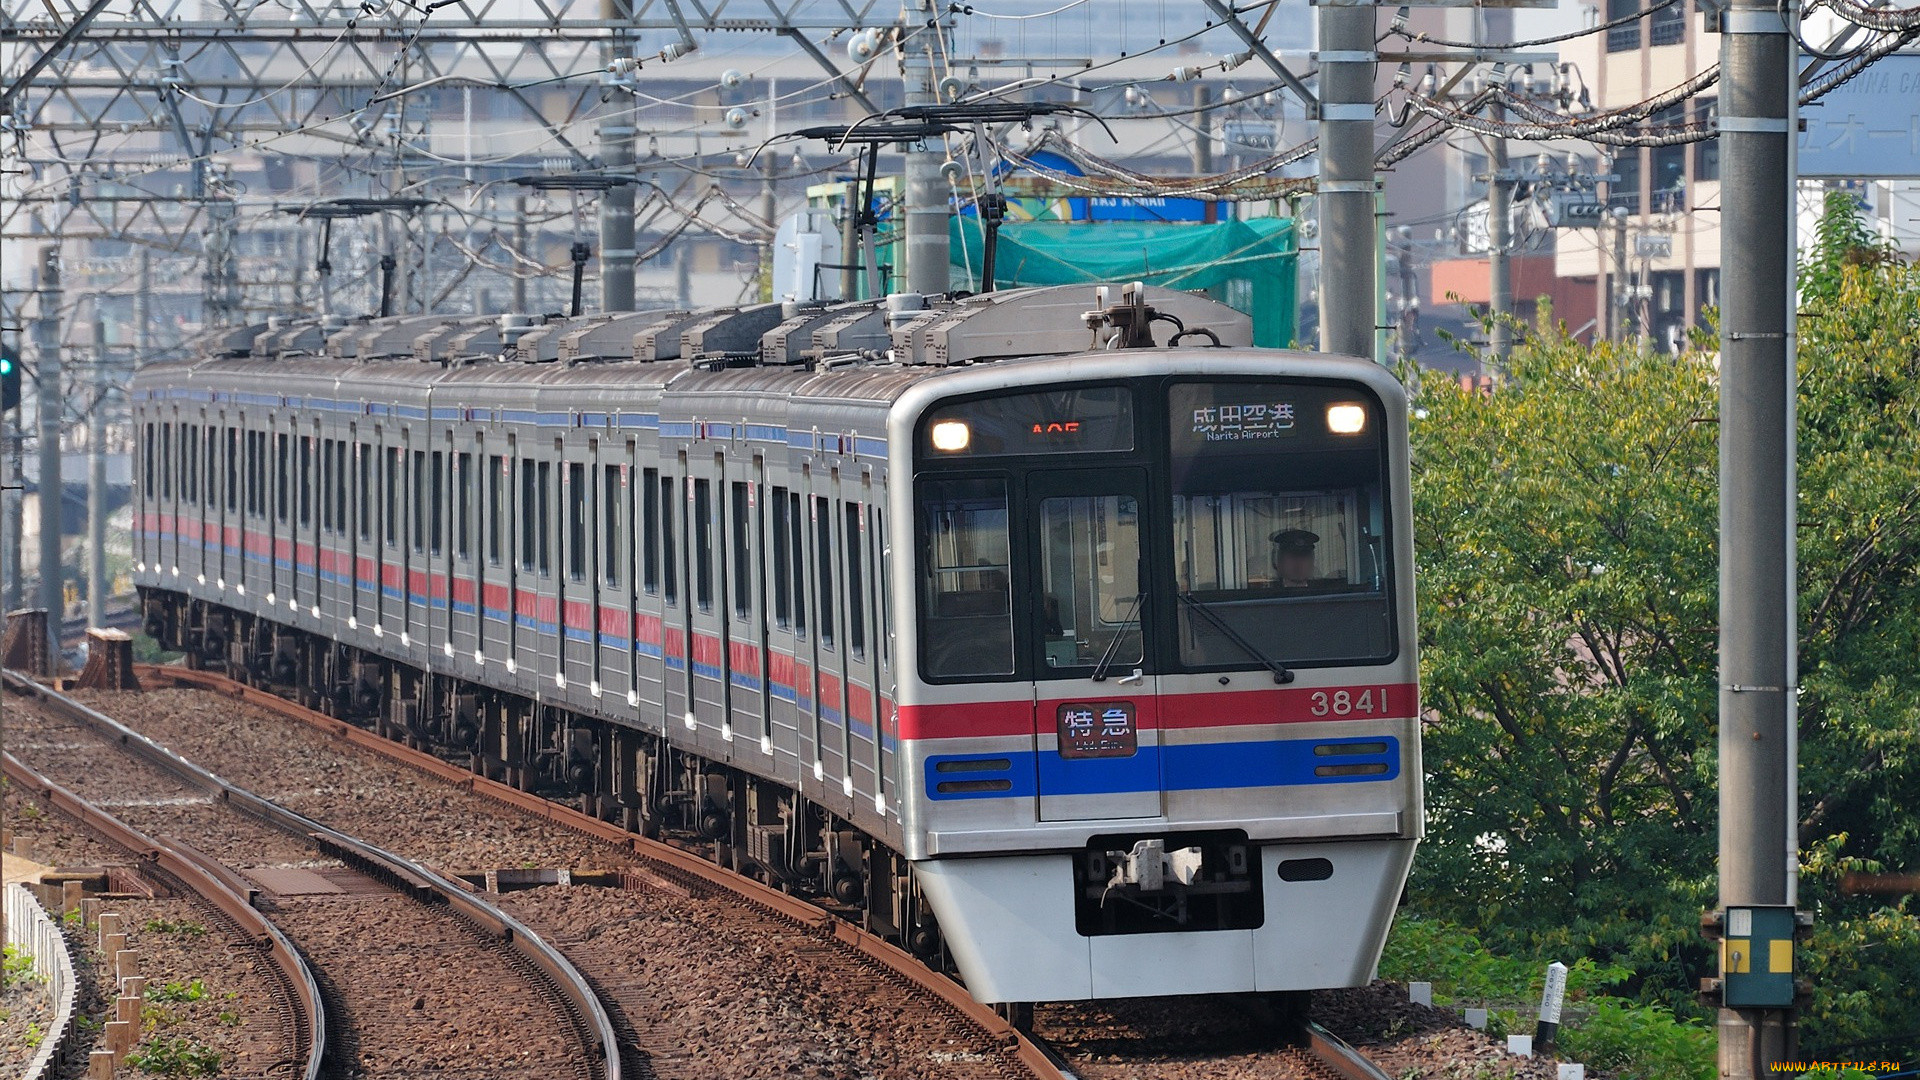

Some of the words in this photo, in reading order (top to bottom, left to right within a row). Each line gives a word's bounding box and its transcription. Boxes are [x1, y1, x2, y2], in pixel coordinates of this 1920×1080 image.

[1192, 403, 1294, 432] 成田空港
[1207, 431, 1239, 441] Narita
[1242, 429, 1279, 440] Airport
[1311, 688, 1388, 717] 3841
[1064, 709, 1131, 738] 特急
